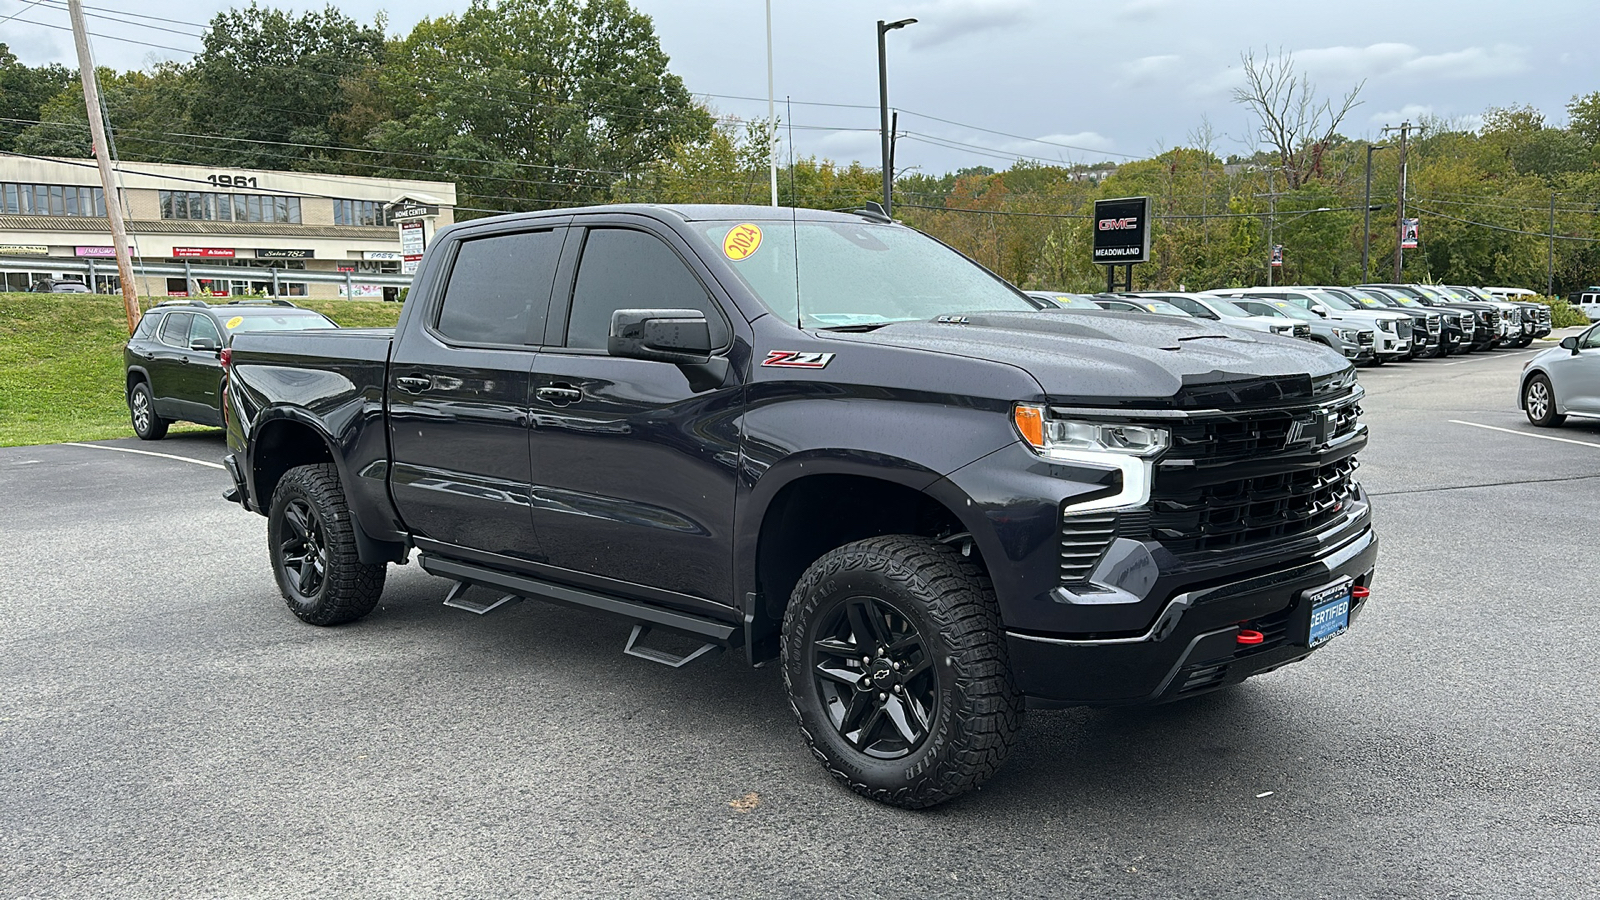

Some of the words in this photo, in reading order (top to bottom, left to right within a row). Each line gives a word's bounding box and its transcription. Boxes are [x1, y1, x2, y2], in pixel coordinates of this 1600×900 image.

[207, 174, 257, 188] 1961
[395, 210, 409, 218] HOME
[409, 208, 427, 217] CENTER
[1099, 217, 1137, 231] GMC
[728, 225, 758, 256] 2024
[287, 250, 306, 258] 782
[1095, 247, 1140, 257] MEADOWLAND
[761, 350, 836, 369] Z71
[1311, 601, 1348, 628] CERTIFIED
[793, 580, 838, 675] GOODYEAR
